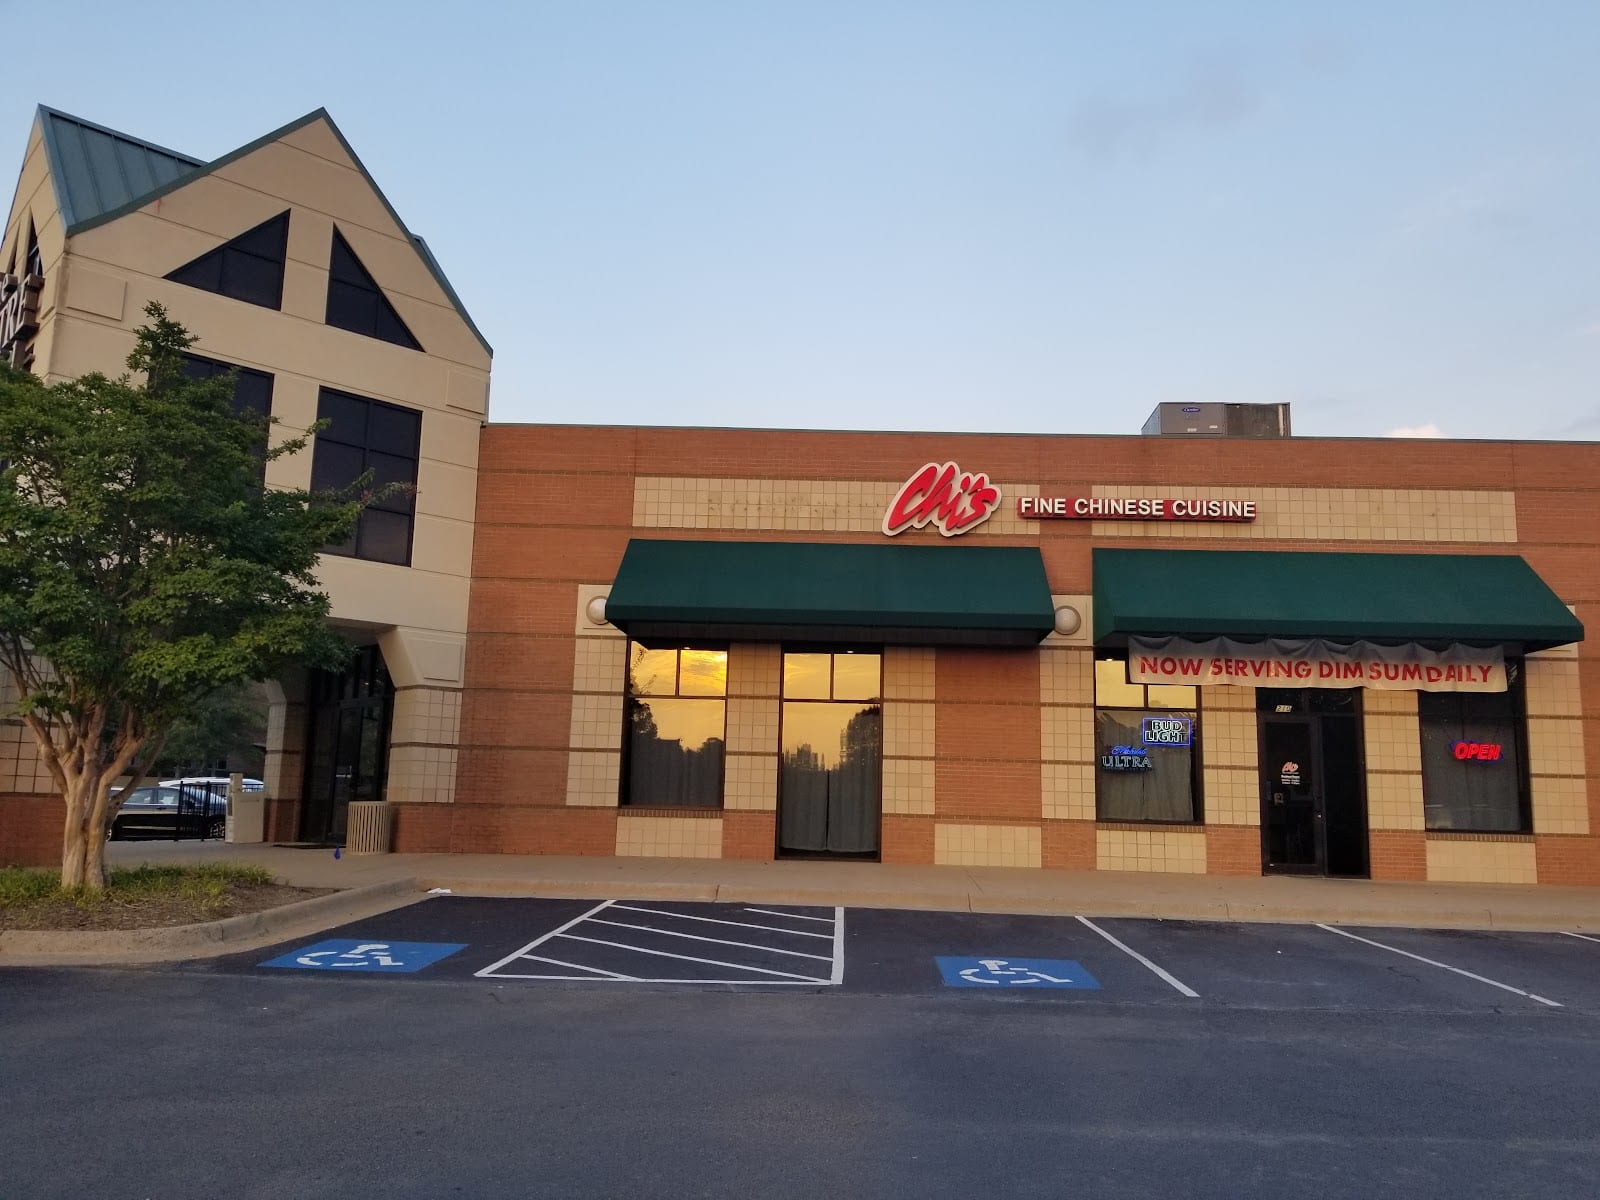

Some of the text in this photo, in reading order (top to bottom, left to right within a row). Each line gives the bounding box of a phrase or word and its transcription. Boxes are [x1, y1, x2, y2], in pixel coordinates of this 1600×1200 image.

[887, 464, 1000, 532] Chi's
[1020, 497, 1256, 518] FINE CHINESE CUISINE
[1140, 656, 1492, 683] NOW SERVING DIM SUM DAILY
[1151, 720, 1183, 731] BUD
[1145, 731, 1187, 742] LIGHT
[1455, 742, 1501, 760] OPEN
[1102, 756, 1152, 768] ULTRA
